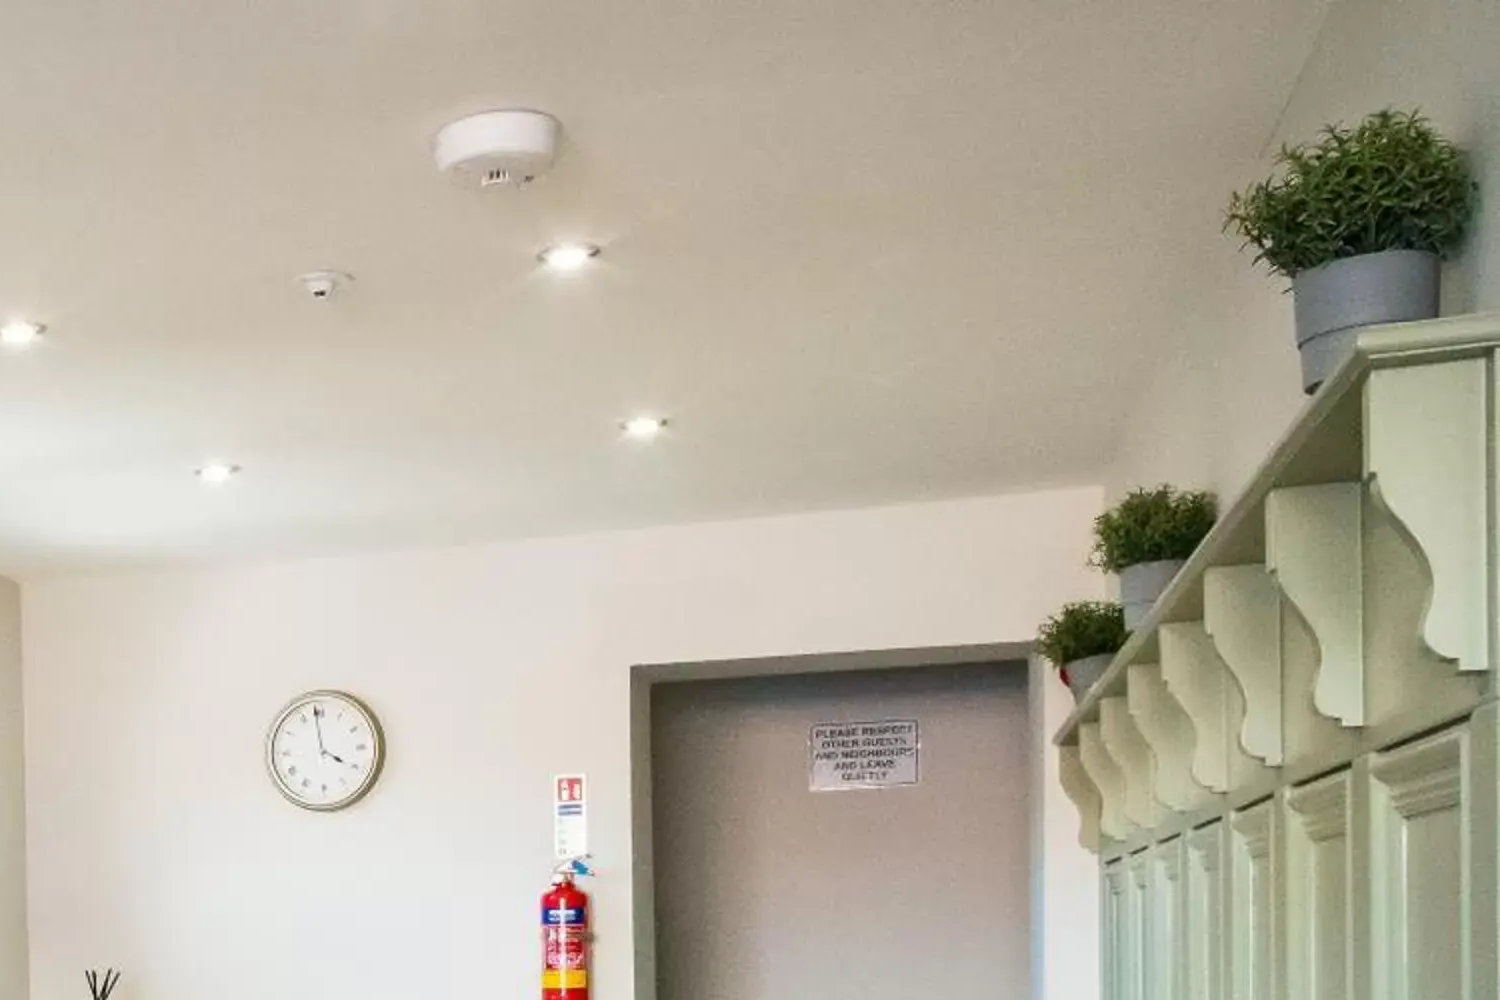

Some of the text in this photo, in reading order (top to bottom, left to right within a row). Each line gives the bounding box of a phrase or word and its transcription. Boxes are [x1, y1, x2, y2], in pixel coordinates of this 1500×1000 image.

[815, 725, 912, 739] PLEASE RESPECT
[822, 736, 907, 749] OTHER GUESTS
[816, 752, 839, 760] AND
[835, 760, 895, 770] AND LEAVE
